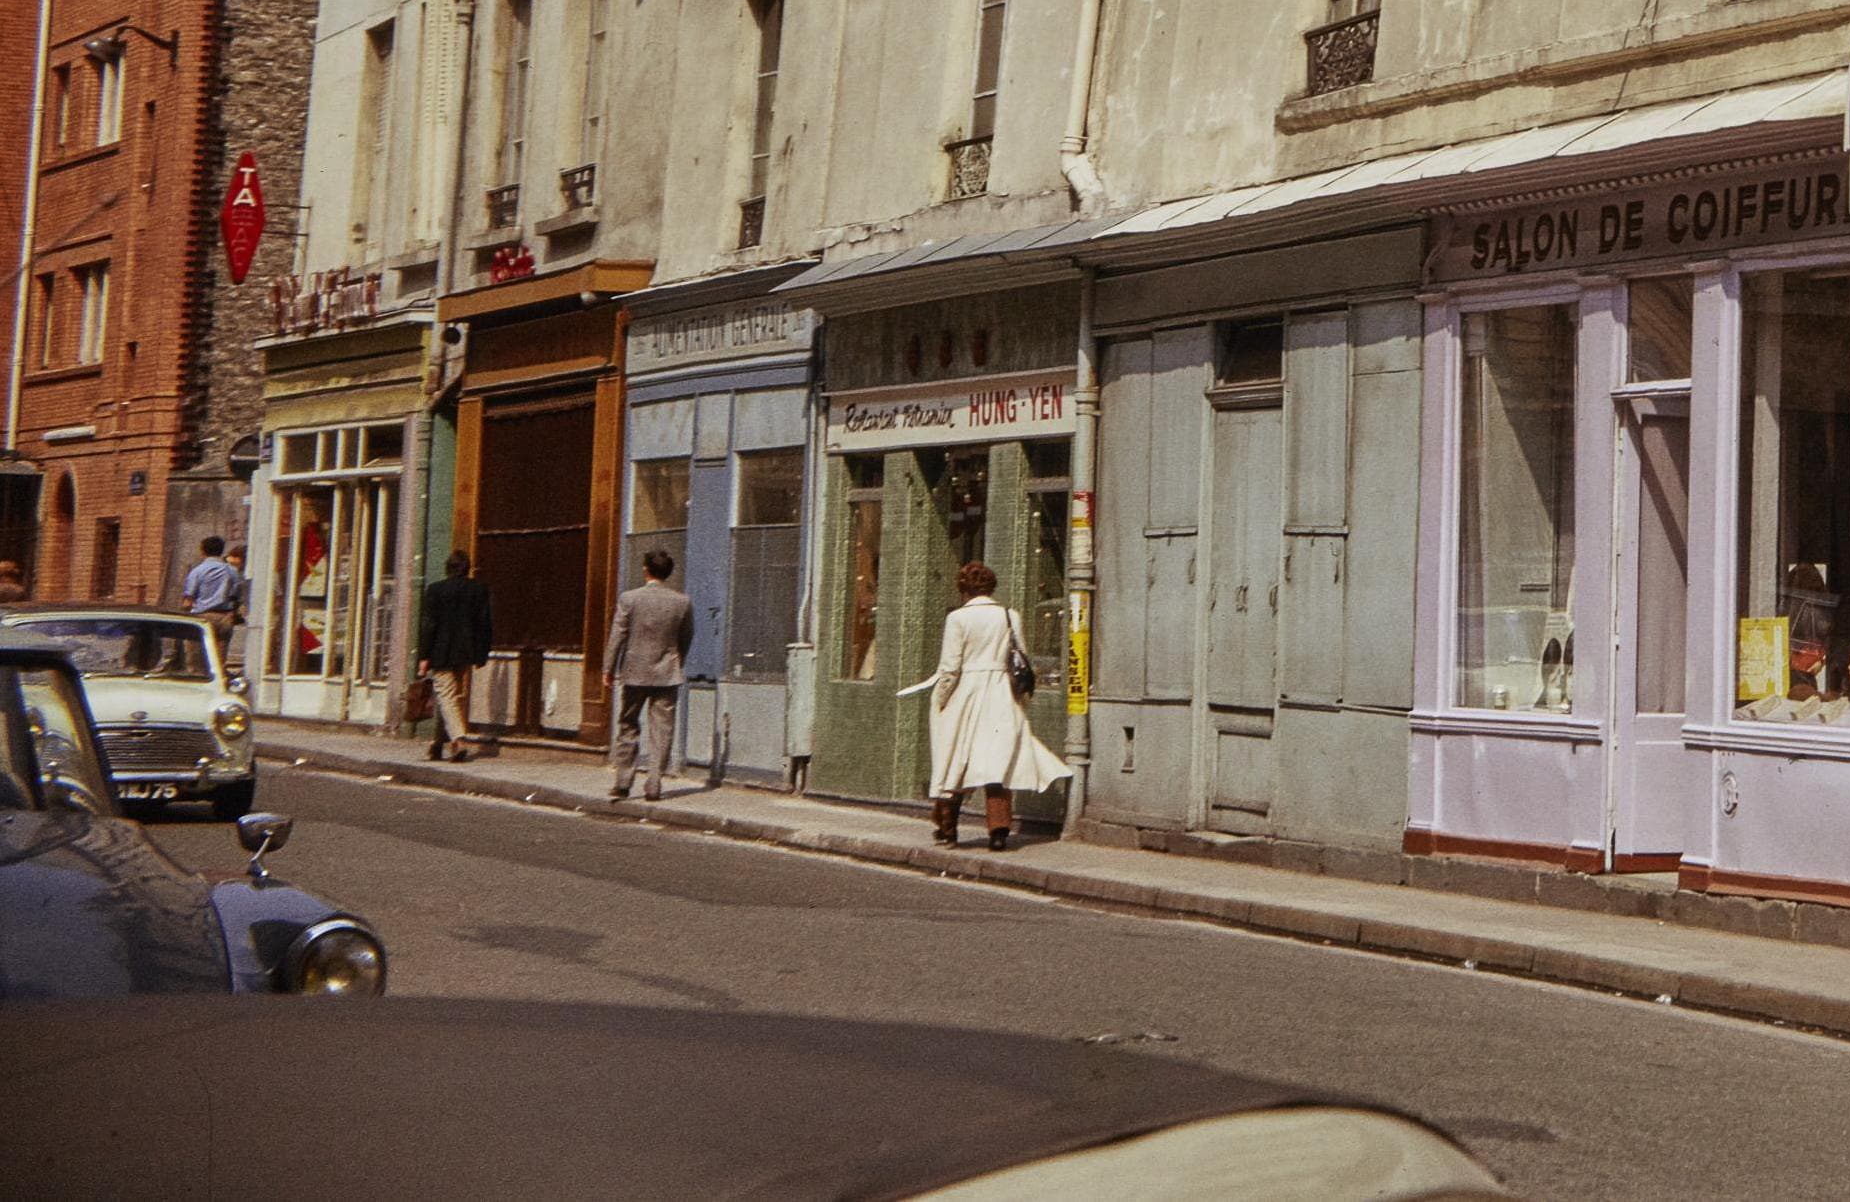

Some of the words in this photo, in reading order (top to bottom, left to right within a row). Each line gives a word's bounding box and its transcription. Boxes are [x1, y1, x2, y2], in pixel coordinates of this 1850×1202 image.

[1470, 209, 1579, 272] SALON
[1599, 200, 1645, 254] DE
[968, 389, 1017, 428] HUNG
